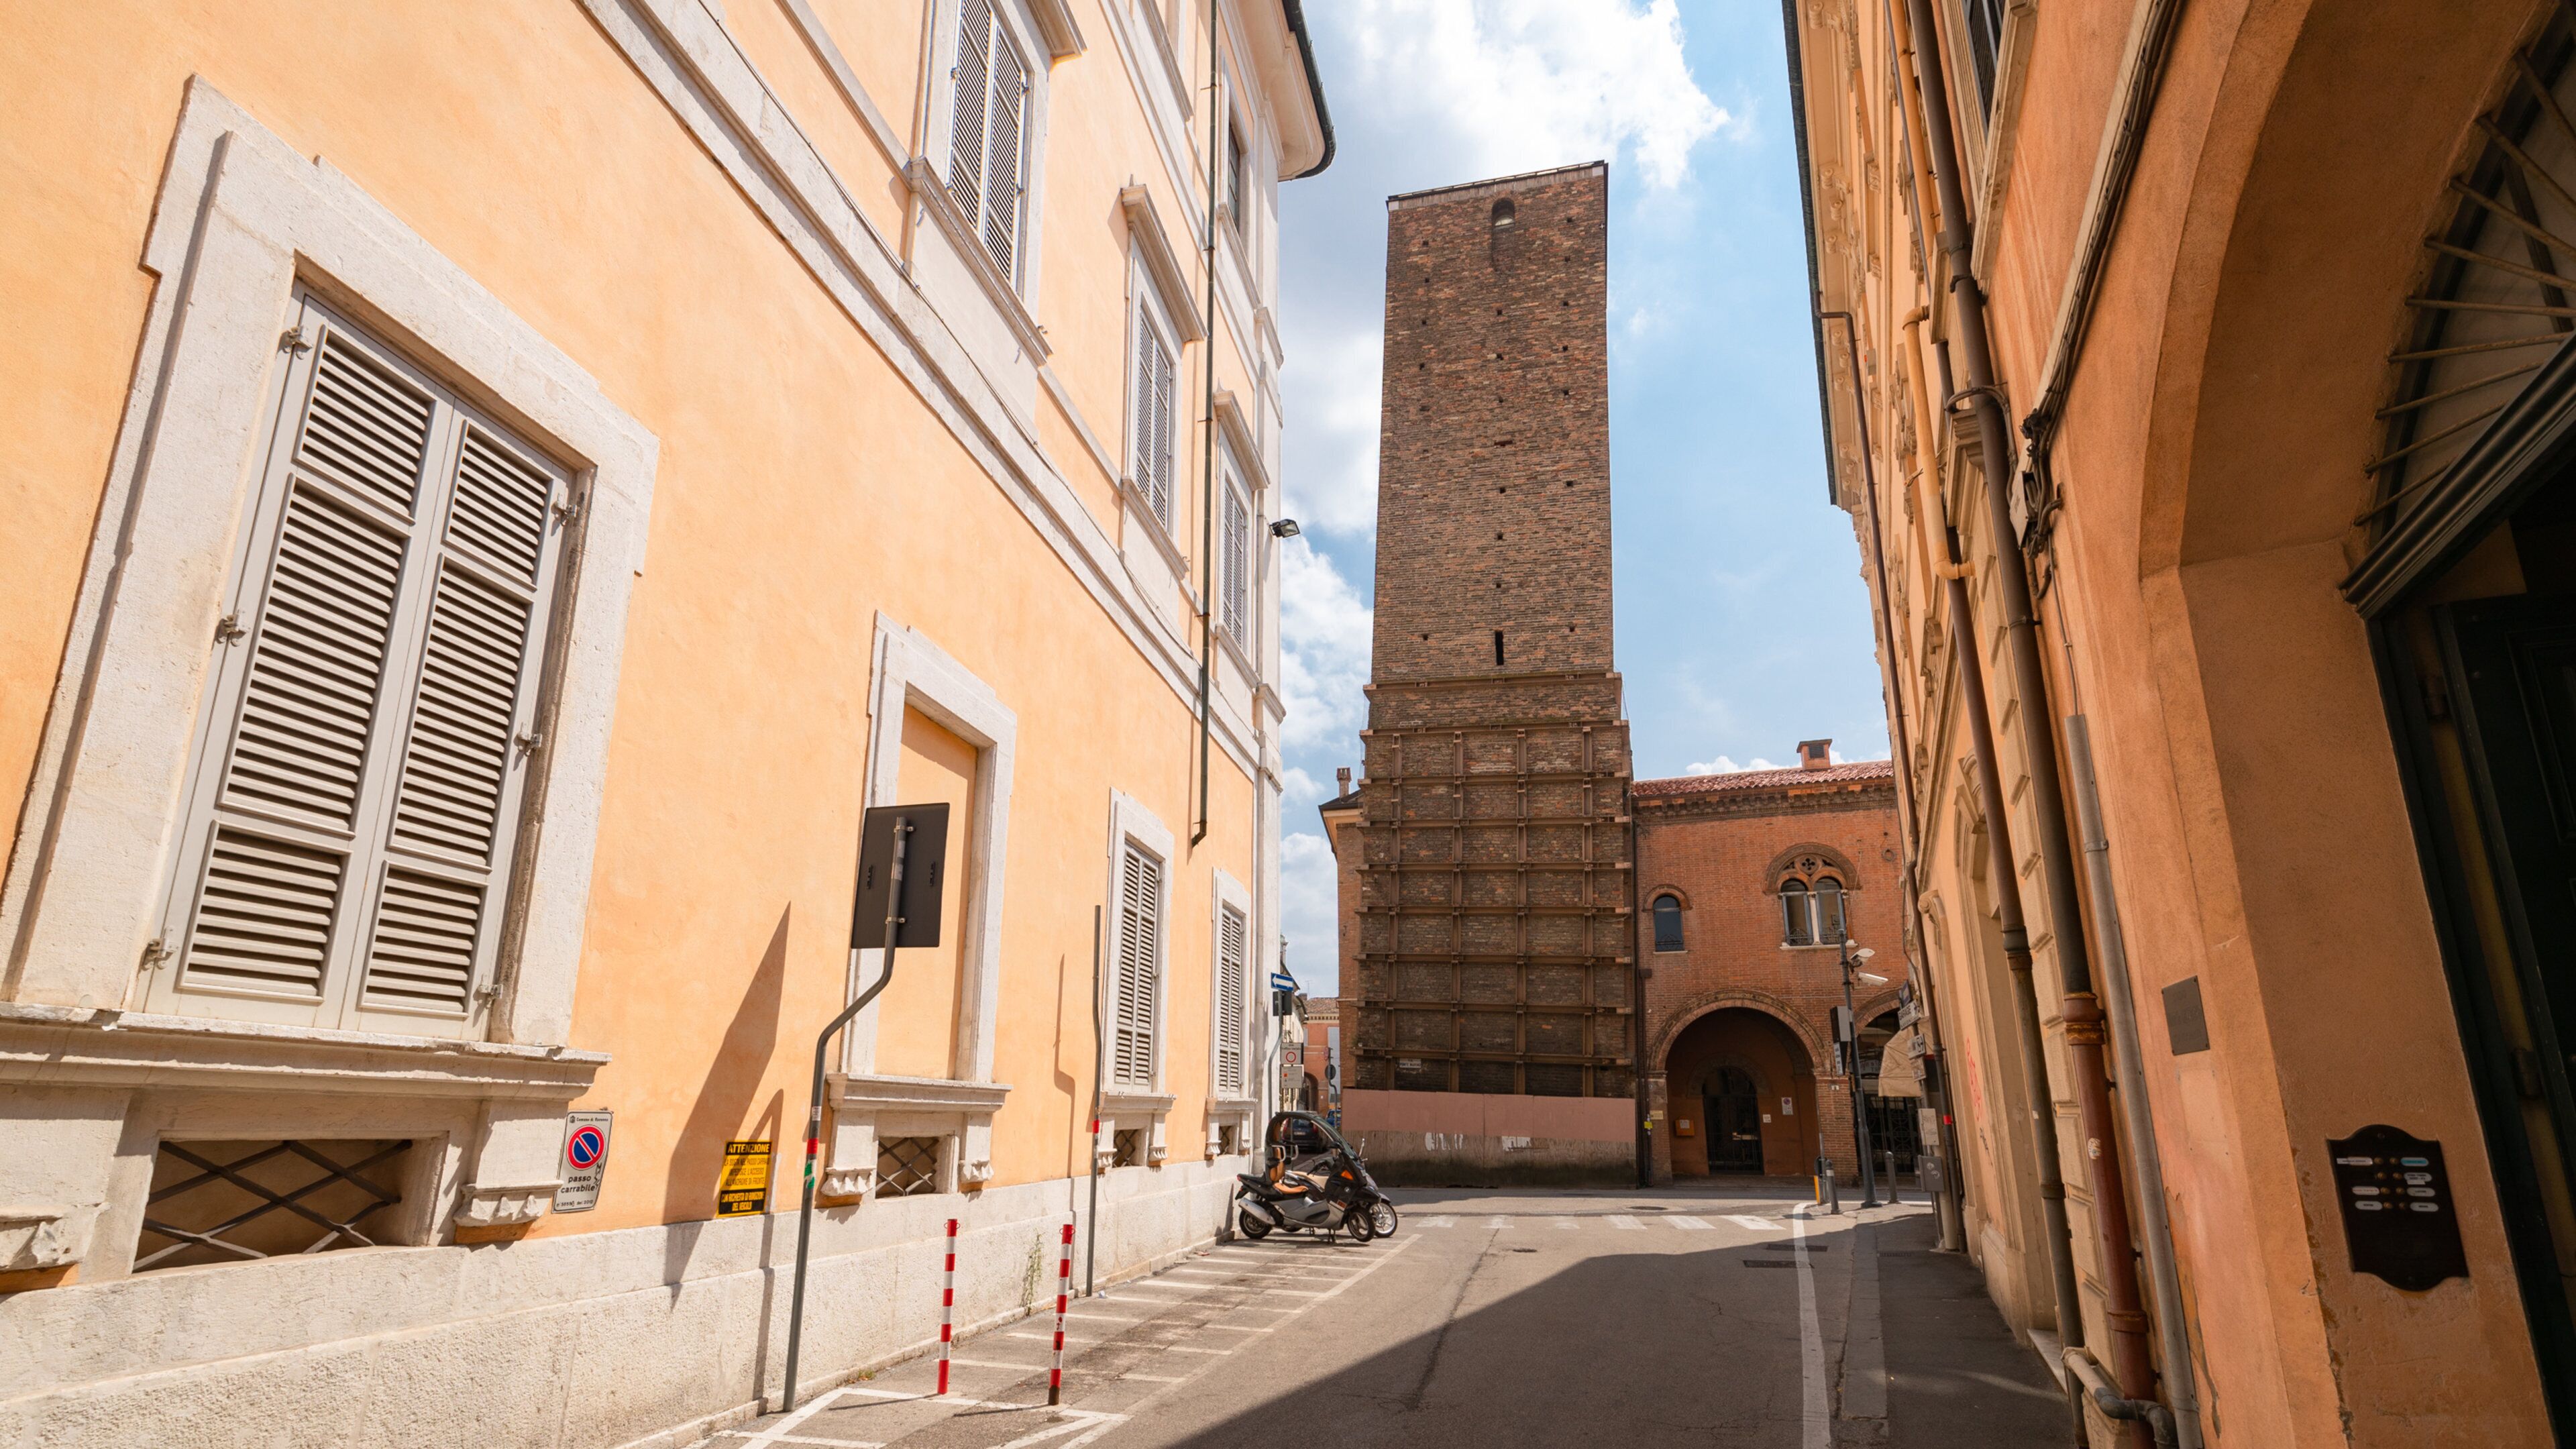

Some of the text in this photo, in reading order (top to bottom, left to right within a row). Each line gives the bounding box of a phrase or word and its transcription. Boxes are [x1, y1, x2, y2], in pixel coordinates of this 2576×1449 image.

[728, 1144, 770, 1153] ATTENZIONE
[568, 1175, 592, 1183] passo
[561, 1184, 595, 1193] carrabile
